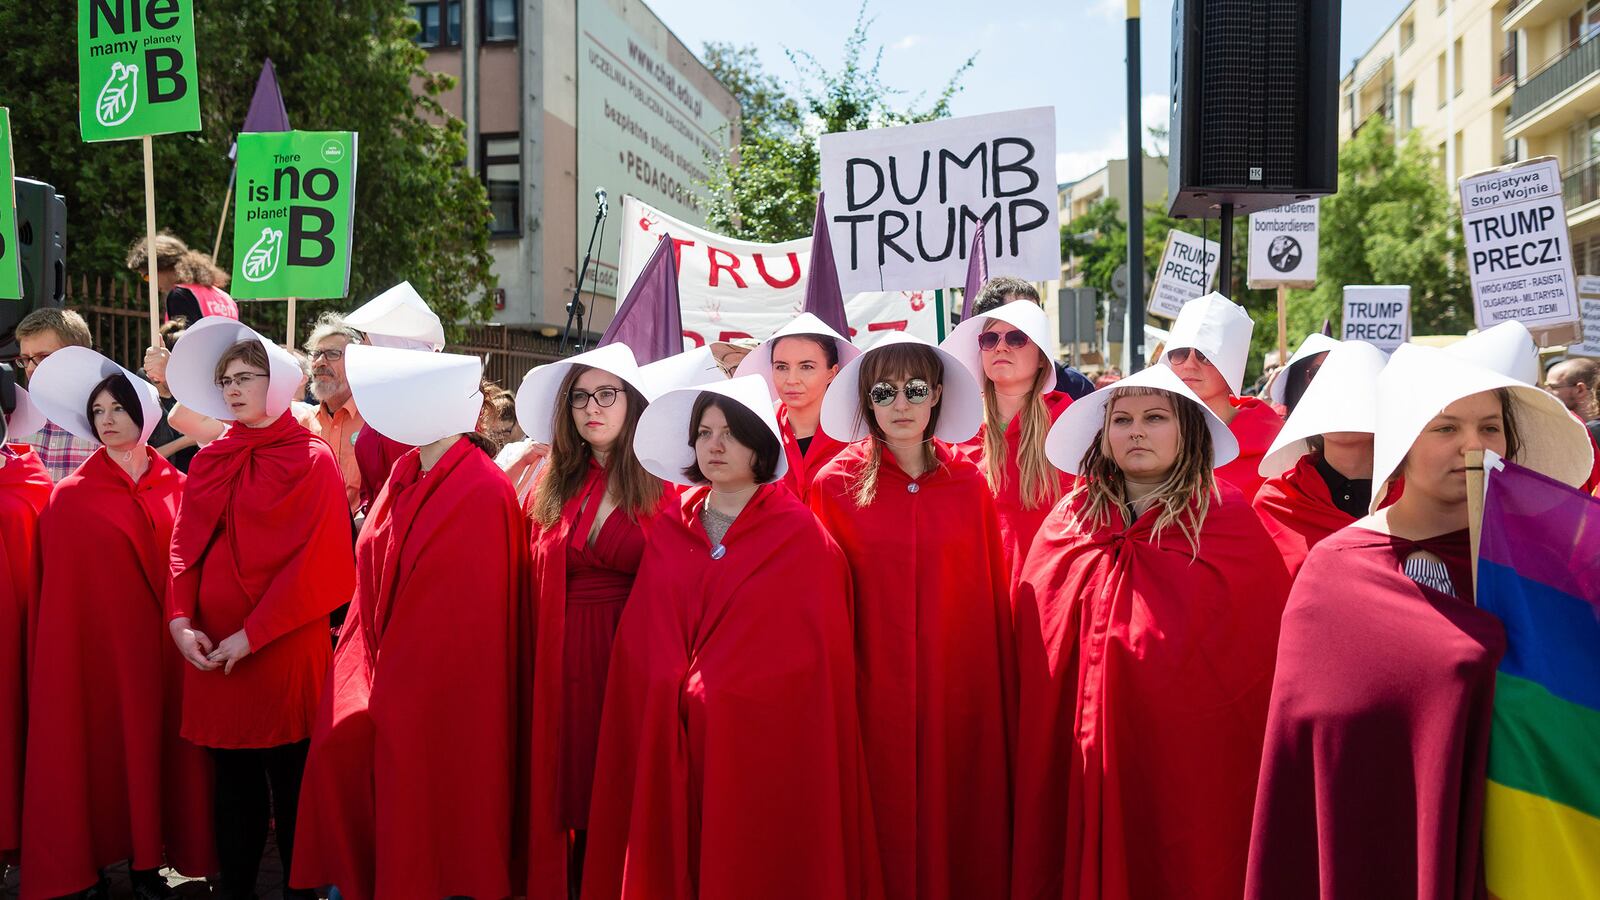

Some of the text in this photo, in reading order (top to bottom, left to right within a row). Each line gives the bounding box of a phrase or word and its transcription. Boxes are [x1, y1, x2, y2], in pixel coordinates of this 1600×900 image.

[90, 35, 182, 57] mamy planety
[145, 47, 188, 104] B
[273, 154, 301, 164] There
[248, 166, 339, 201] is no
[846, 137, 1039, 211] DUMB
[1475, 172, 1540, 193] Inicjatywa
[1471, 183, 1549, 207] Stop Wojnie
[247, 205, 335, 267] planet B
[833, 199, 1050, 270] TRUMP
[1254, 218, 1316, 232] bombardierem
[1469, 205, 1555, 243] TRUMP
[1172, 241, 1216, 267] TRUMP
[1473, 237, 1562, 275] PRECZ!
[1164, 260, 1211, 288] PRECZ!
[1480, 283, 1502, 294] WRÓG
[1503, 279, 1527, 291] KOBIET
[1532, 274, 1563, 287] RASISTA
[1523, 288, 1565, 302] MILITARYSTA
[1348, 302, 1403, 319] TRUMP
[1538, 303, 1558, 315] ZIEMI
[1345, 324, 1402, 340] PRECZ!
